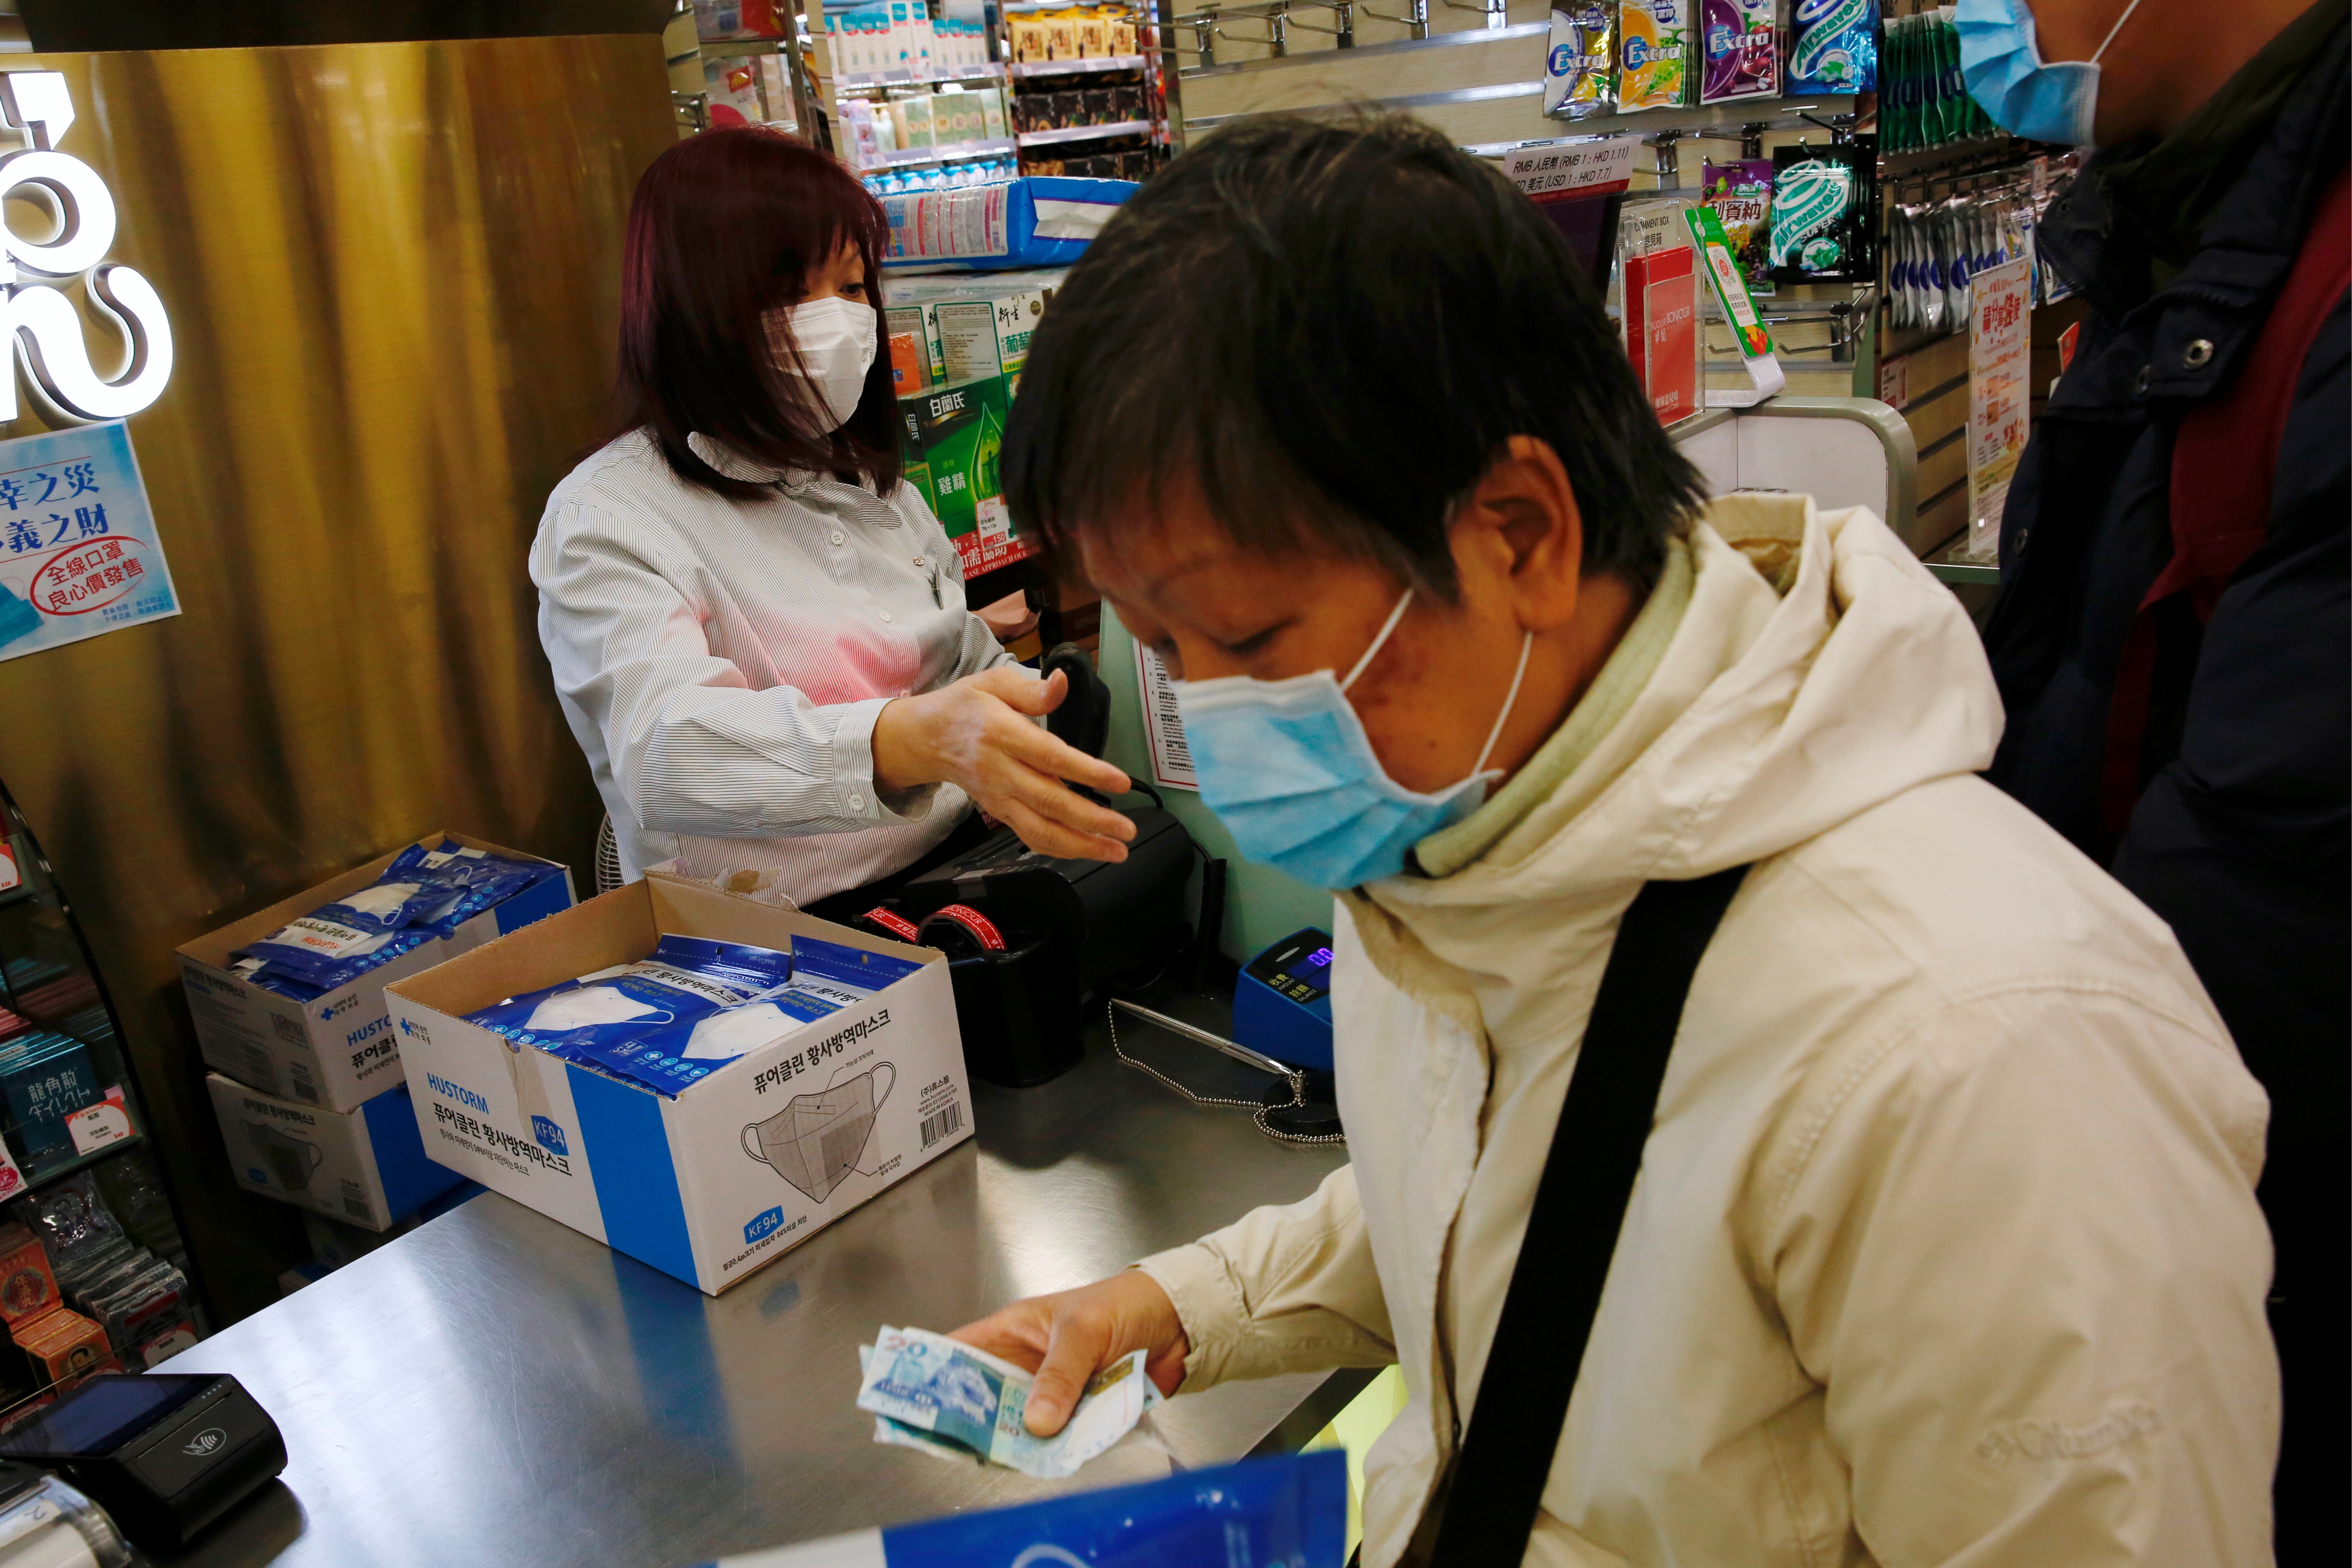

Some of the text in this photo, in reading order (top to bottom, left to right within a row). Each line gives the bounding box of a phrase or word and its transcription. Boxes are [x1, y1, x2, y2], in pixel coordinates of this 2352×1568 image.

[1628, 43, 1681, 65] Extra
[1710, 32, 1769, 53] Extra
[1554, 51, 1604, 71] Extra
[1513, 160, 1533, 174] RMB
[1533, 156, 1559, 172] 人民幣
[1559, 154, 1581, 170] (RMB
[1593, 149, 1609, 164] HKD
[1611, 145, 1629, 160] 1.11)
[1514, 180, 1526, 191] SD
[1526, 176, 1544, 191] 美元
[1545, 174, 1566, 189] (USD
[1578, 168, 1595, 183] HKD
[1597, 166, 1612, 180] 7.7)
[1635, 216, 1669, 232] COMMENT BOX
[1774, 180, 1841, 255] Airwaves
[1800, 216, 1837, 243] SUPER
[1644, 232, 1662, 247] 意見箱
[1666, 306, 1690, 324] BONJOUR
[1005, 330, 1035, 354] 葡萄
[929, 391, 965, 418] 白蘭氏
[0, 463, 100, 511] 幸之災
[938, 471, 966, 496] 雞精
[0, 503, 109, 553] 義之財
[993, 533, 1006, 544] 150
[47, 540, 125, 586] 全線口罩
[964, 551, 1028, 579] EASE APPROACH OUR
[48, 557, 144, 612] 良心價發售
[949, 906, 983, 925] BONJOUR
[1307, 948, 1335, 966] 0.0
[656, 971, 739, 1003] 황사방역마스크
[1269, 973, 1289, 986] 收費
[1278, 978, 1296, 991] AMOUNT
[817, 987, 862, 1004] 황사방
[1298, 989, 1317, 1002] BALANCE
[754, 1053, 805, 1095] 퓨어클린
[807, 1008, 891, 1066] 황사방역마스크
[845, 1059, 858, 1068] 기능성
[28, 1069, 78, 1103] 龍角散
[427, 1072, 490, 1114] HUSTORM
[920, 1084, 954, 1106] www.hustorm.com
[921, 1075, 950, 1097] (주)휴스톰
[918, 1102, 933, 1113] 제품문의
[924, 1107, 936, 1117] MADE
[940, 1097, 954, 1107] KOREA
[433, 1102, 572, 1177] 퓨어클린 황사방역마스크
[534, 1120, 565, 1147] KF94
[440, 1128, 530, 1176] 황사와 미세먼지 94%이상 차단하는 마스크
[889, 1161, 900, 1170] 디자인
[749, 1212, 778, 1238] KF94
[756, 1235, 775, 1250] 미세입자
[776, 1221, 796, 1238] 94%이상
[797, 1215, 807, 1225] 차단
